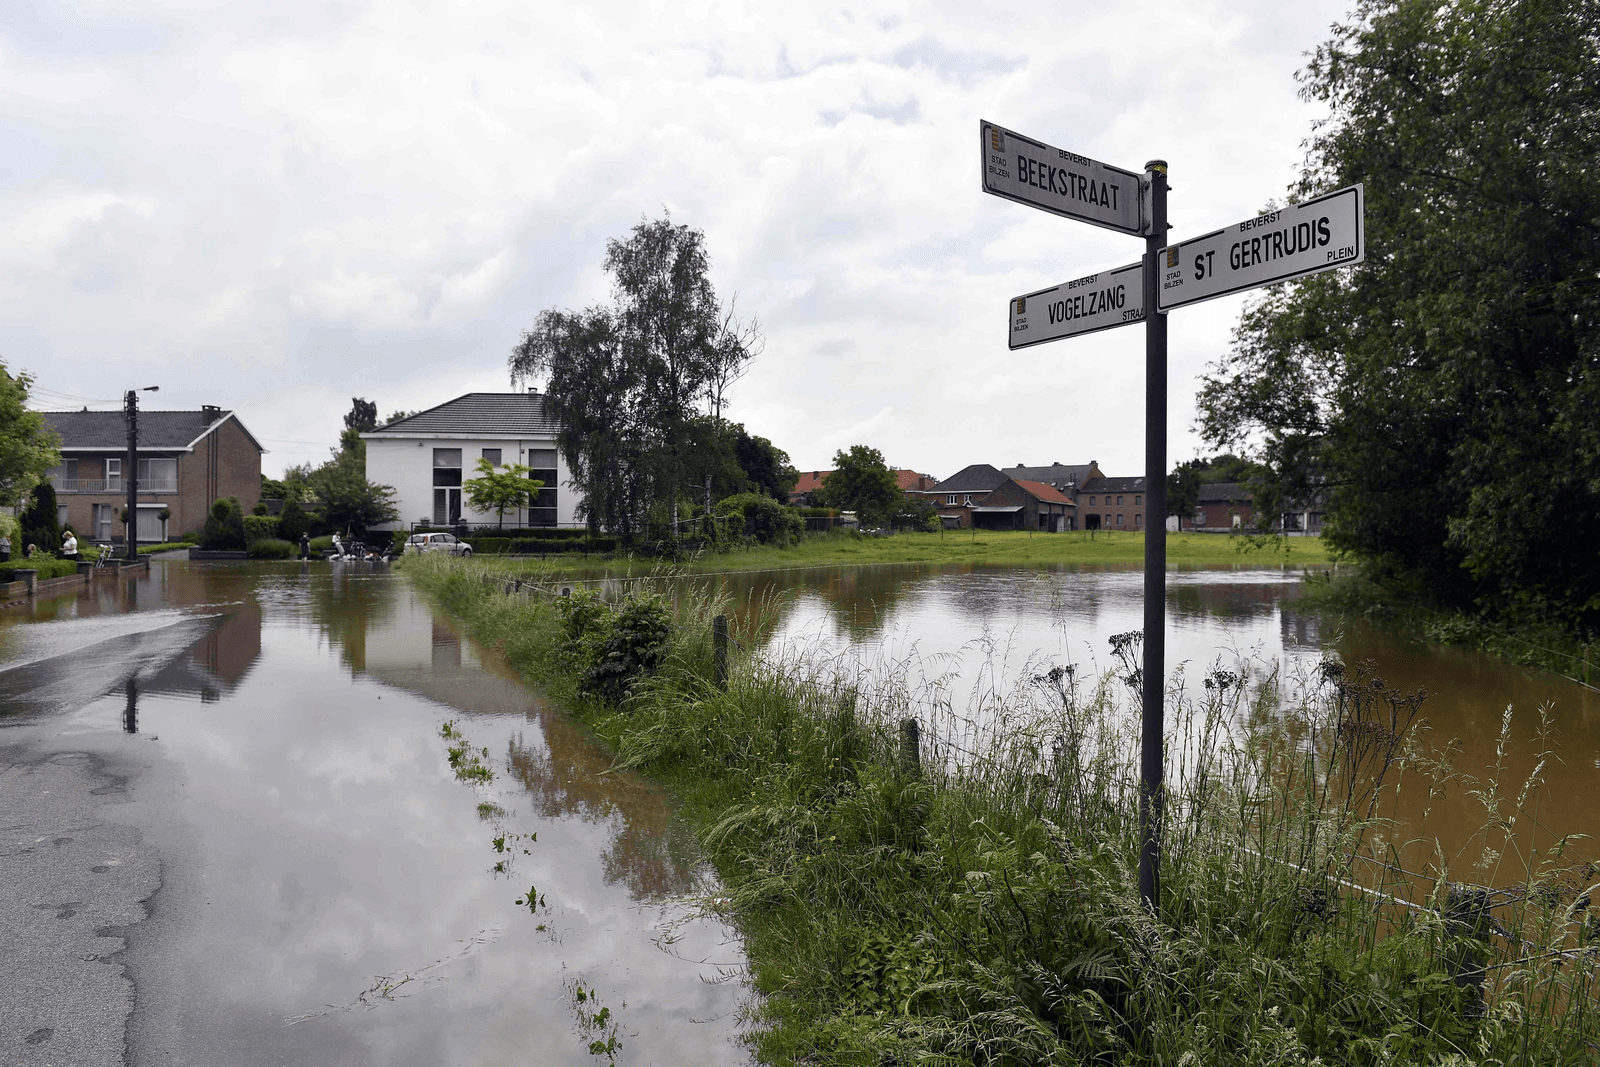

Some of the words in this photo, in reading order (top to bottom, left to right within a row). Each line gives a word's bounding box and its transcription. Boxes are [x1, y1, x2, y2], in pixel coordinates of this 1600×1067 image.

[991, 155, 1006, 166] STAD
[1058, 149, 1091, 167] BEVERST
[989, 166, 1009, 178] BILZEN
[1018, 154, 1119, 211] BEEKSTRAAT
[1240, 210, 1282, 232] BEVERST
[1194, 250, 1216, 281] ST
[1230, 216, 1330, 270] GERTRUDIS
[1327, 245, 1354, 262] PLEIN
[1069, 274, 1098, 289] BEVERST
[1164, 278, 1184, 290] BILZEN
[1166, 270, 1181, 281] STAD
[1048, 284, 1125, 325] VOGELZANG
